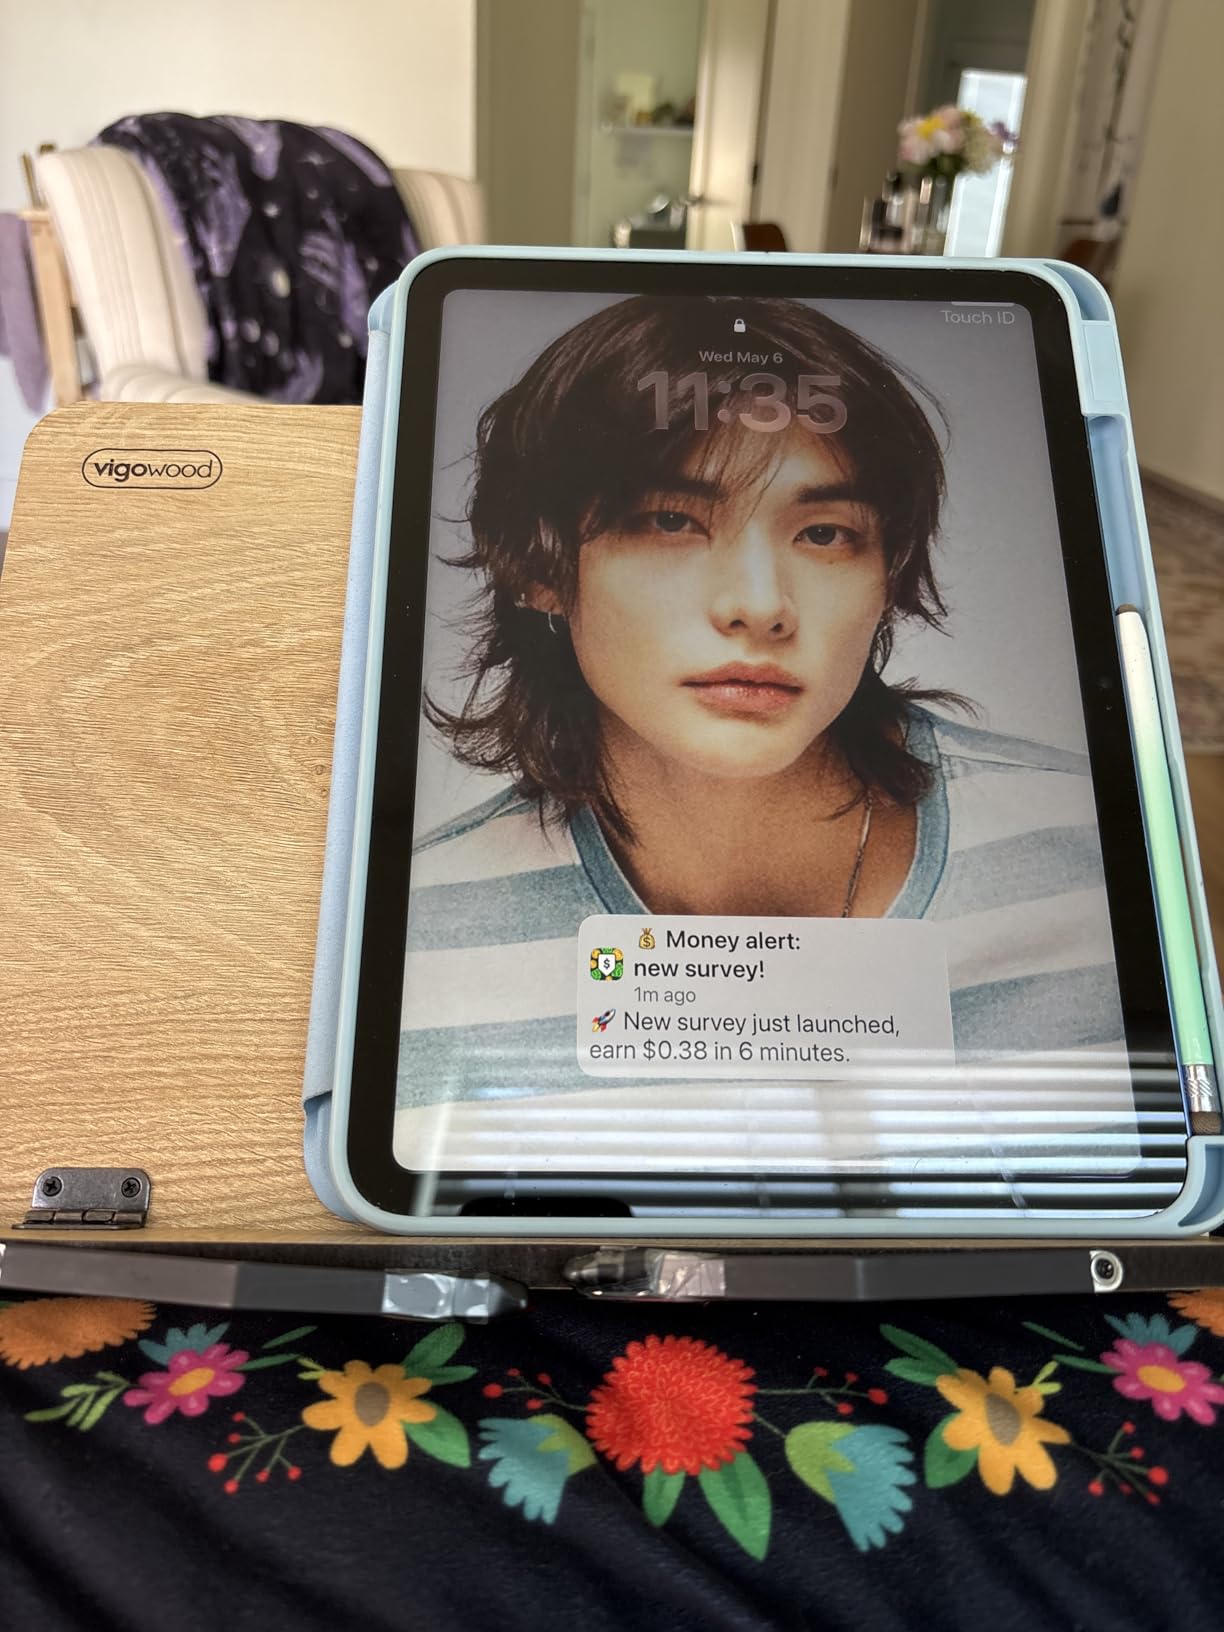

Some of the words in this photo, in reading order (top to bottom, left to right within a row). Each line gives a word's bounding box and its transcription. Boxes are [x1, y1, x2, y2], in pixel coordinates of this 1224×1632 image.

[941, 309, 993, 325] Touch
[998, 311, 1015, 326] ID
[699, 351, 733, 363] Wed
[737, 351, 770, 366] May
[773, 352, 783, 364] 6
[637, 371, 848, 434] 11:35
[93, 458, 213, 483] vigowood
[666, 930, 740, 952] Money
[745, 931, 801, 951] alert:
[634, 961, 679, 978] new
[685, 961, 765, 982] survey!
[634, 987, 659, 1003] 1m
[664, 989, 697, 1006] ago
[623, 1011, 671, 1032] New
[677, 1016, 747, 1036] survey
[752, 1014, 790, 1036] just
[796, 1013, 900, 1037] launched,
[589, 1044, 637, 1061] earn
[642, 1039, 708, 1062] $0.38
[714, 1041, 732, 1061] in
[738, 1041, 754, 1061] 6
[760, 1043, 851, 1063] minutes.
